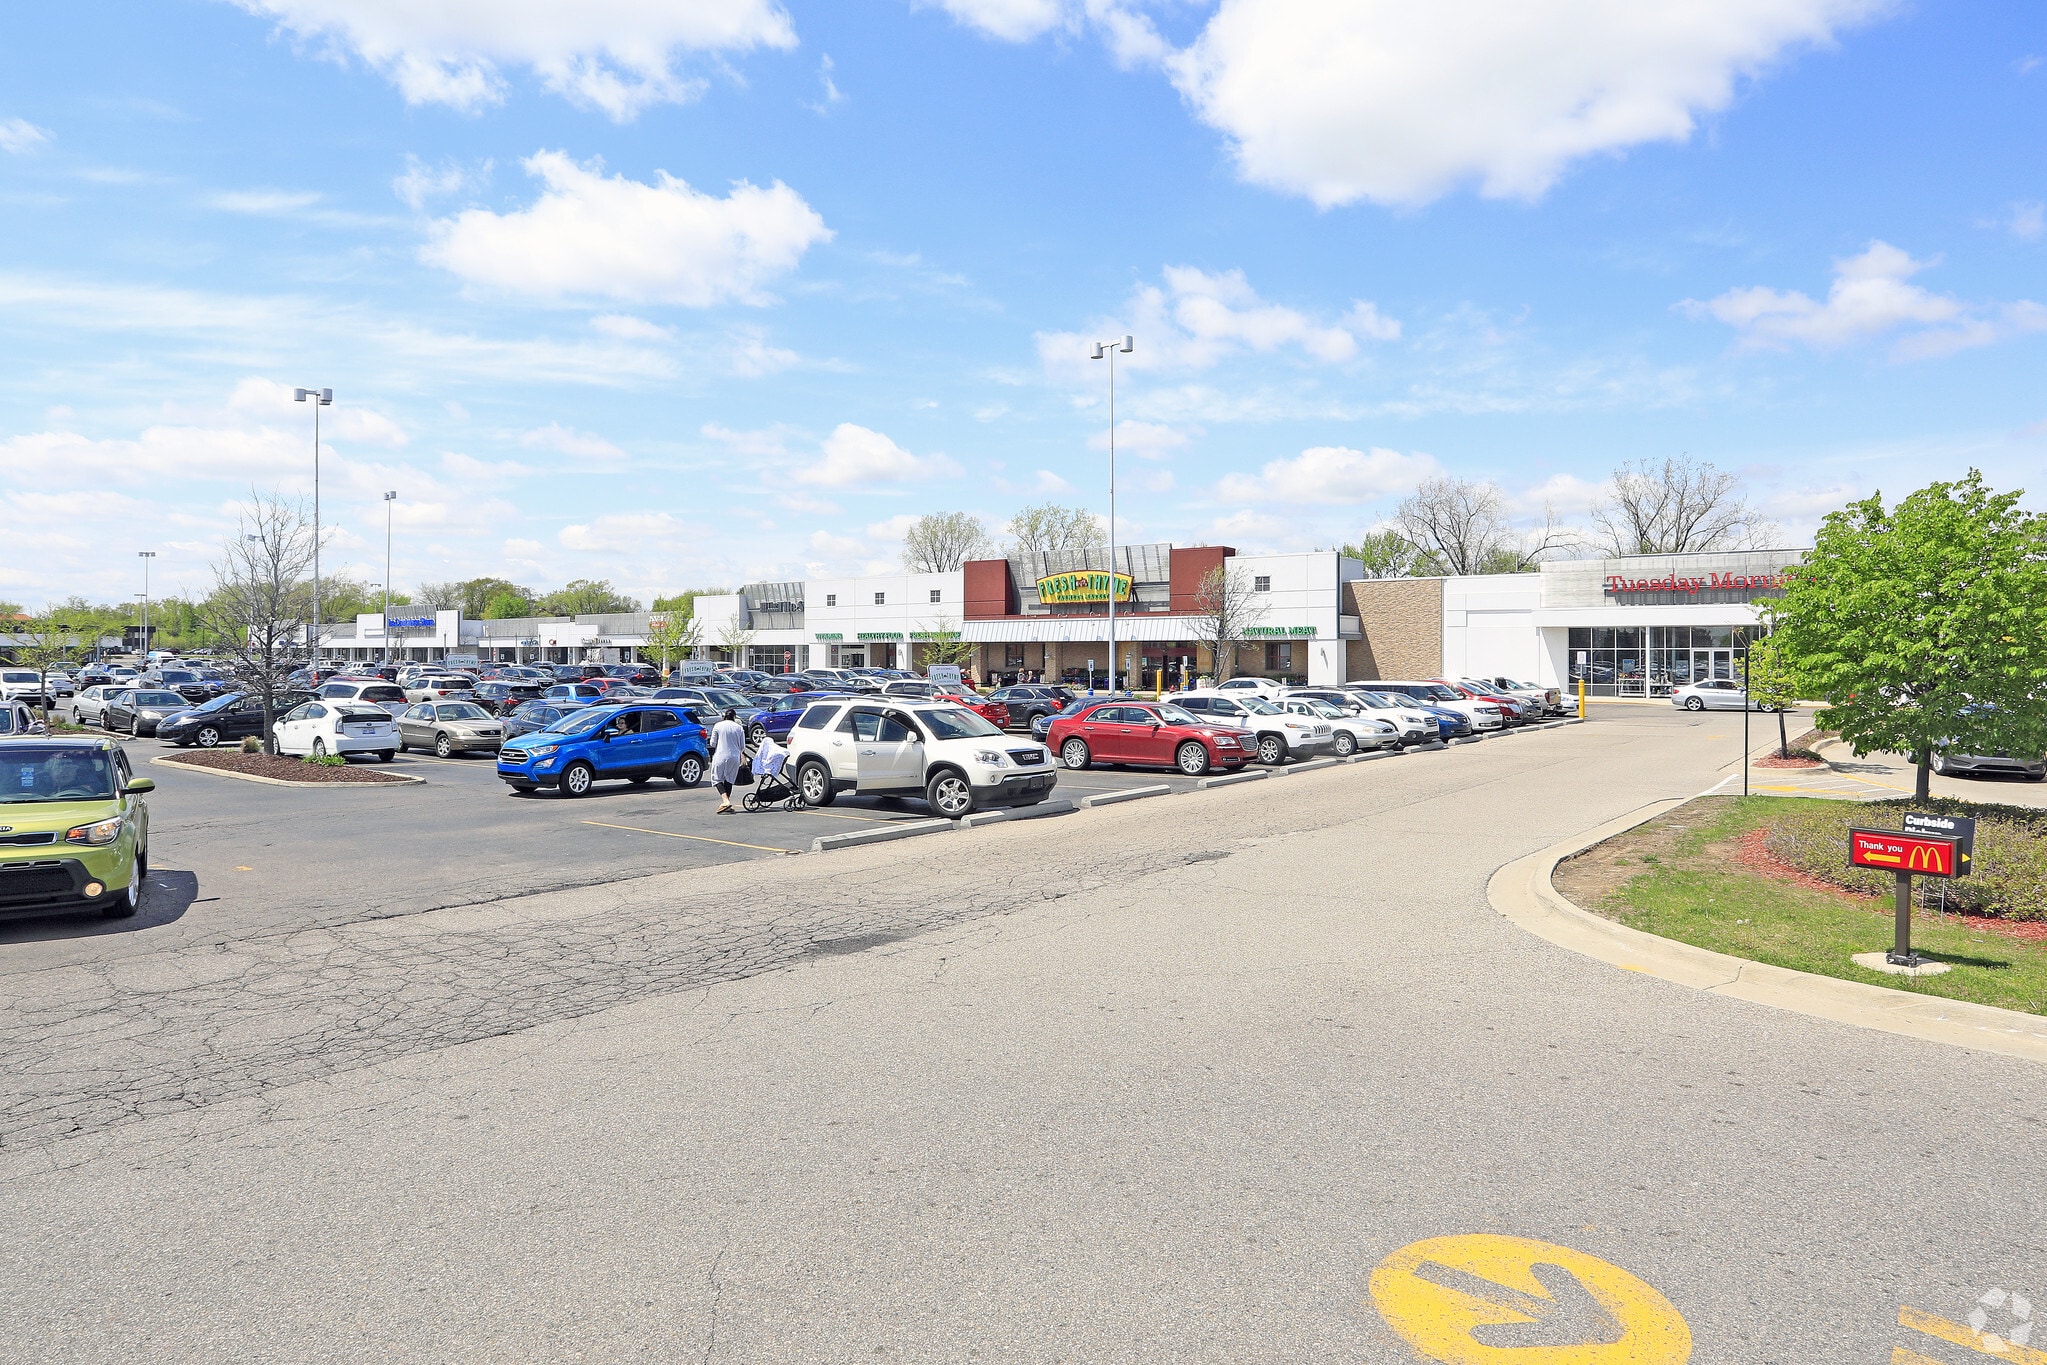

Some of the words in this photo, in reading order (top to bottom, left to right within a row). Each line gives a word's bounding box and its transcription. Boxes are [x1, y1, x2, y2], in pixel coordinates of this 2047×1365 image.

[1038, 575, 1077, 597] FRESH
[1607, 574, 1704, 594] Tuesday
[1242, 626, 1287, 636] NATURAL
[1288, 626, 1317, 636] MEAT
[1905, 815, 1954, 829] Curbside
[1859, 840, 1884, 851] Thank
[1887, 844, 1903, 853] you
